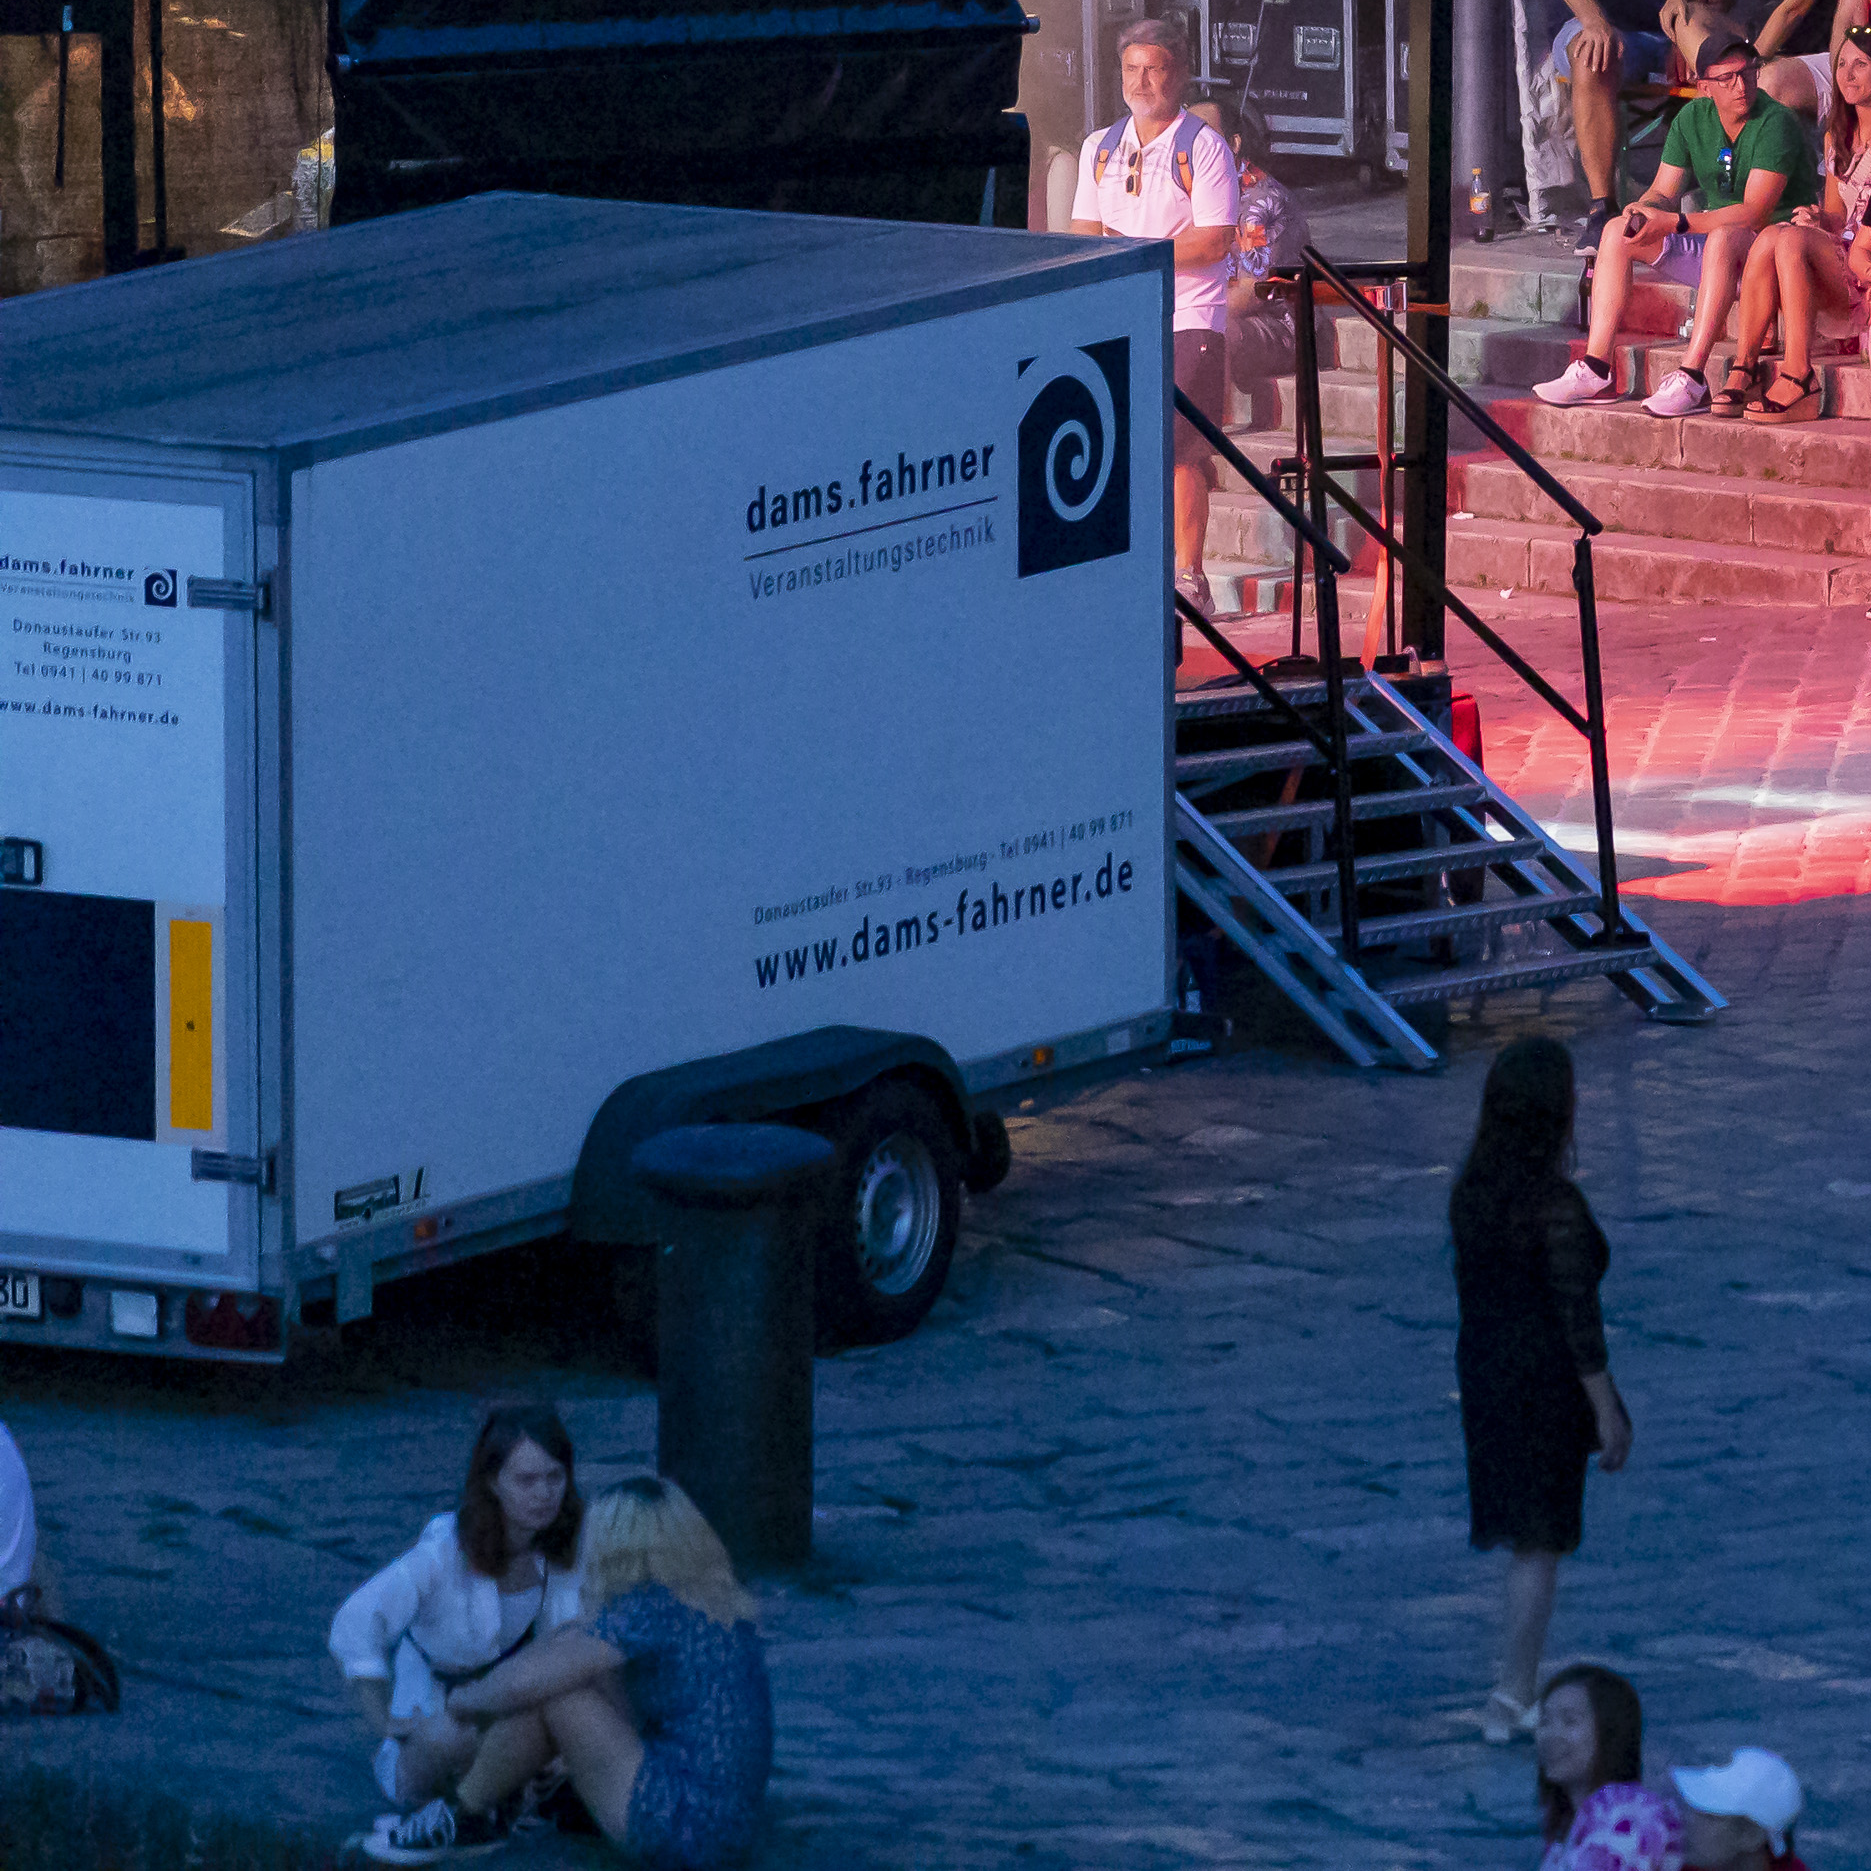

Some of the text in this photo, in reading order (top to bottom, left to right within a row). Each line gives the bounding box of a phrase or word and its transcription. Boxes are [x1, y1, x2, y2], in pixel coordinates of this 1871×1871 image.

[746, 443, 995, 534] dams.fahrner
[0, 556, 135, 580] dams.fahrner
[749, 516, 997, 601] Veranstaltungstechnik
[43, 641, 132, 664] Regensburg
[754, 885, 849, 925] Donaustaufer
[904, 850, 988, 888] Regensburg
[1000, 837, 1019, 859] Tel
[756, 851, 1133, 989] www.dams-fahrner.de
